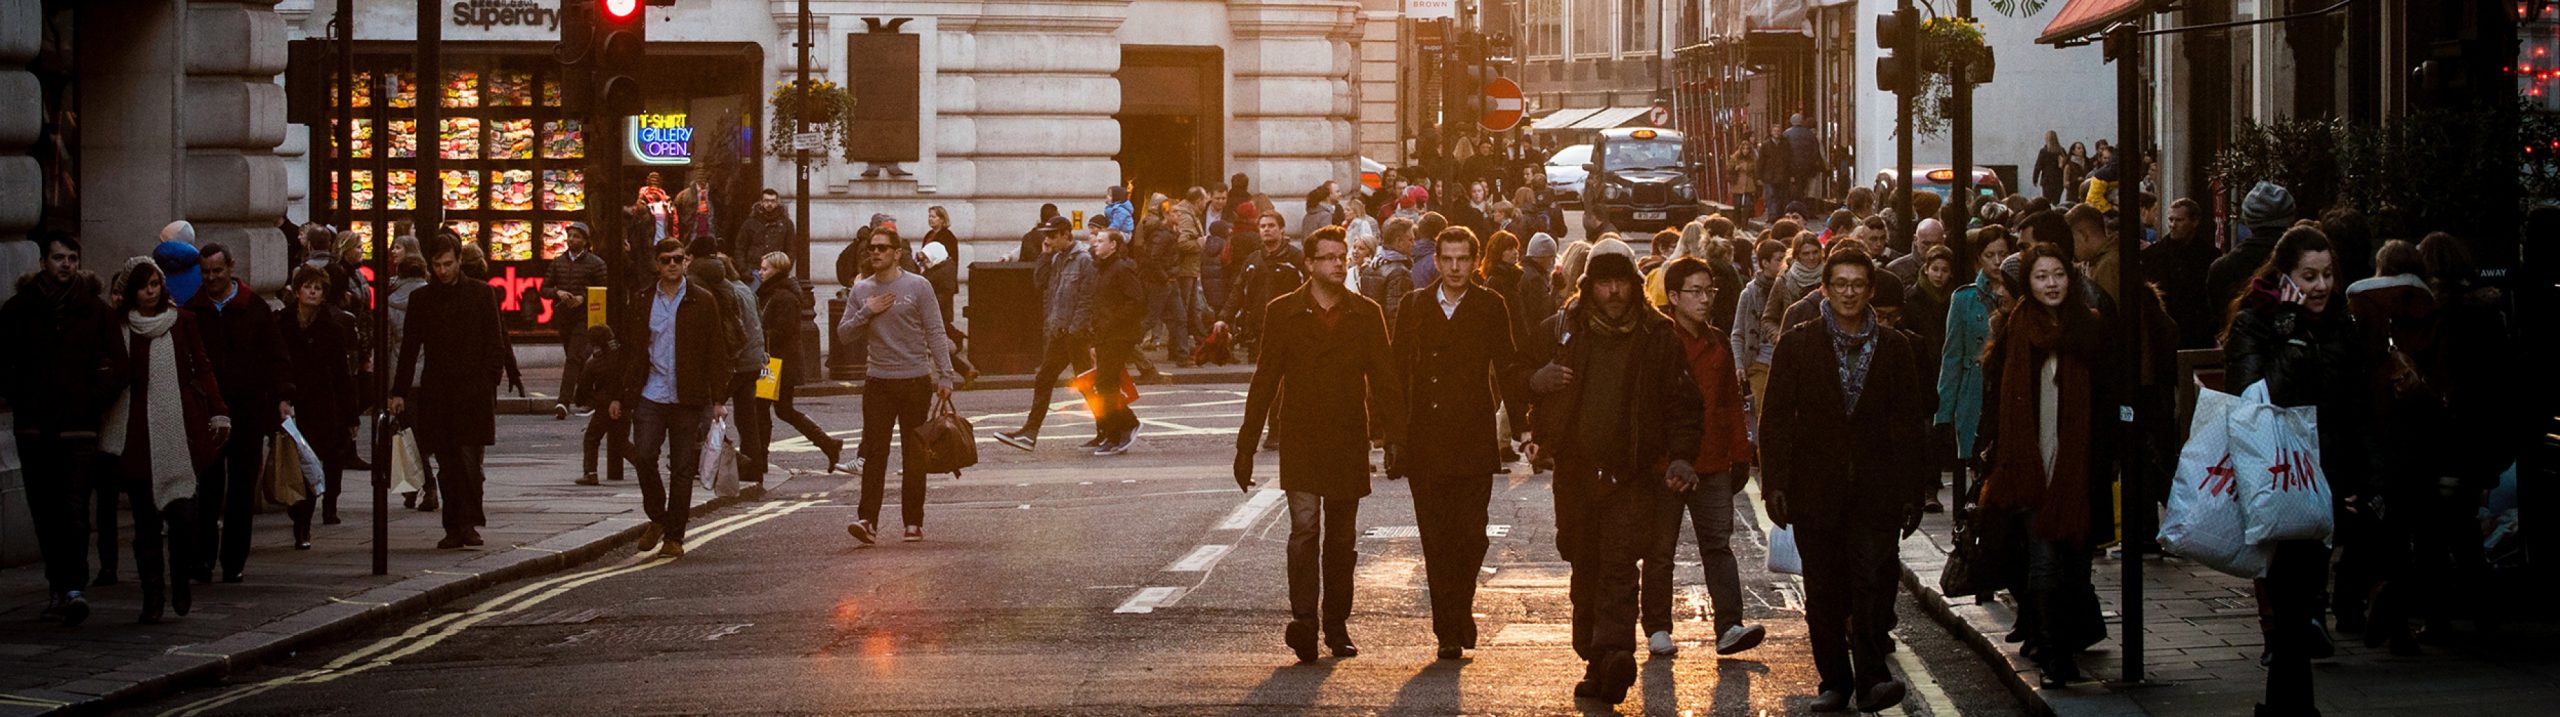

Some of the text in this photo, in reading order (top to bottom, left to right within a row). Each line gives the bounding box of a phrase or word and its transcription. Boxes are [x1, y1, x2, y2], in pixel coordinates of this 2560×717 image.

[453, 2, 560, 31] Superdry
[639, 114, 687, 128] T-SHIRT
[642, 128, 693, 142] GALLERY
[2479, 267, 2507, 278] AWAY
[2268, 447, 2318, 494] H&M
